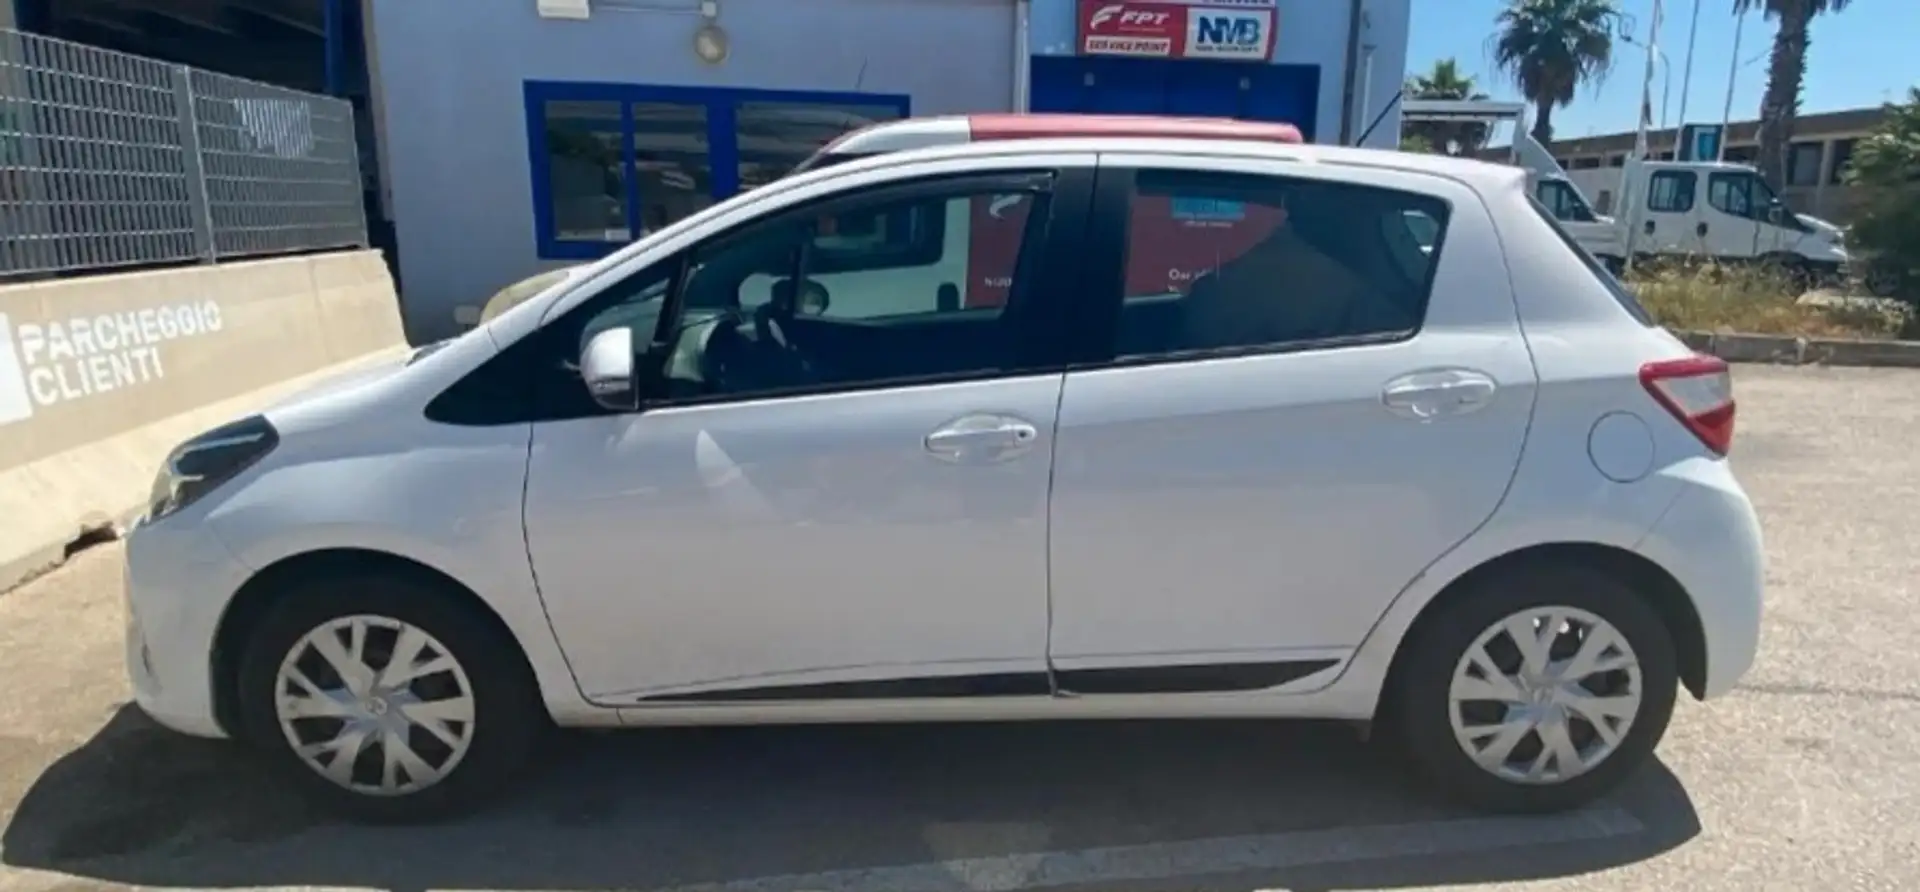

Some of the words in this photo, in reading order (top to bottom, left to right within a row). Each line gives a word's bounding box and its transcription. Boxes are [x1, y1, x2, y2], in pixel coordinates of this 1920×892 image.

[1119, 11, 1169, 25] FPT
[18, 300, 223, 365] PARCHEGGIO
[29, 347, 164, 405] CLIENTI
